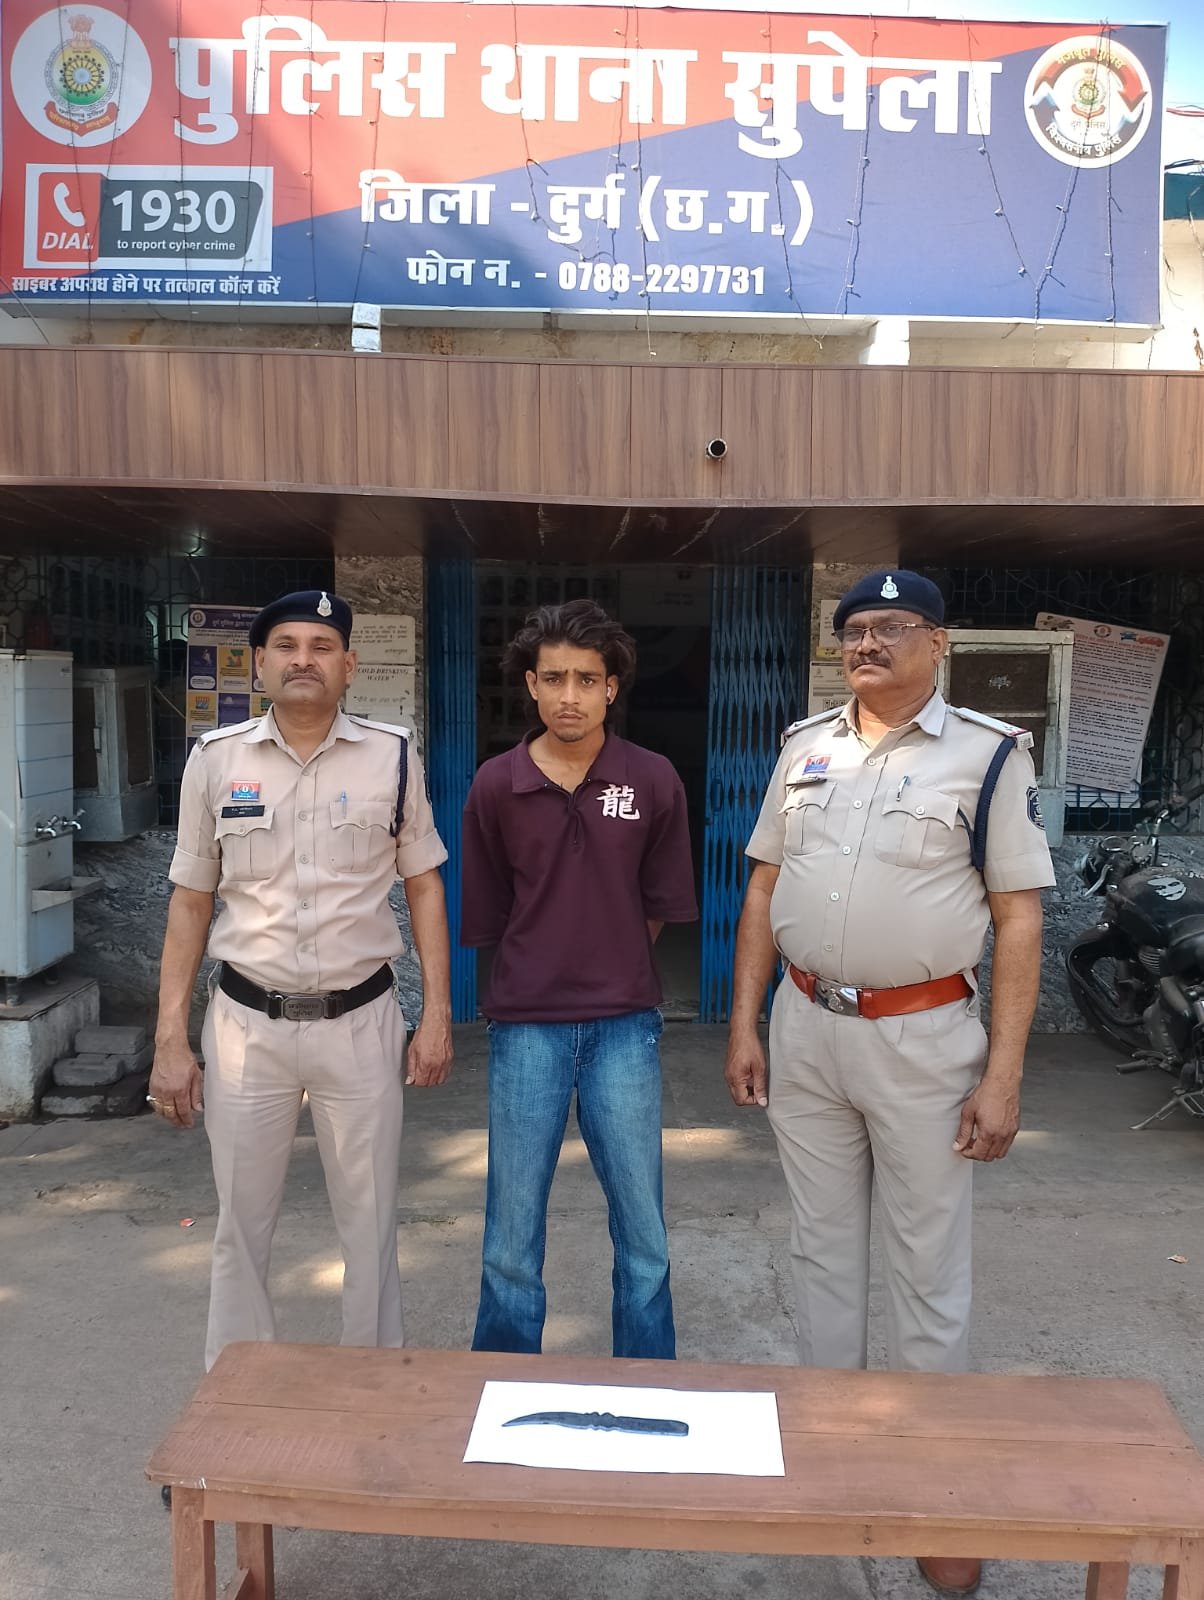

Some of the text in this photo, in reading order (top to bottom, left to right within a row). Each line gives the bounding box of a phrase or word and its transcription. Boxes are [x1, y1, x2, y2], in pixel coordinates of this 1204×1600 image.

[169, 15, 1002, 159] पुलिस थाना सुपेला
[112, 189, 236, 234] 1930
[358, 168, 496, 224] जिला
[511, 202, 529, 211] -
[547, 173, 626, 244] दुर्ग
[42, 231, 94, 250] DIAL
[117, 239, 236, 252] to report cyber crime
[11, 273, 281, 295] साइबर अपराध होने पर तत्काल कॉल करें
[406, 250, 476, 286] फोन
[483, 259, 521, 289] न.
[558, 261, 765, 295] 0788-2297731
[596, 783, 640, 820] 龍
